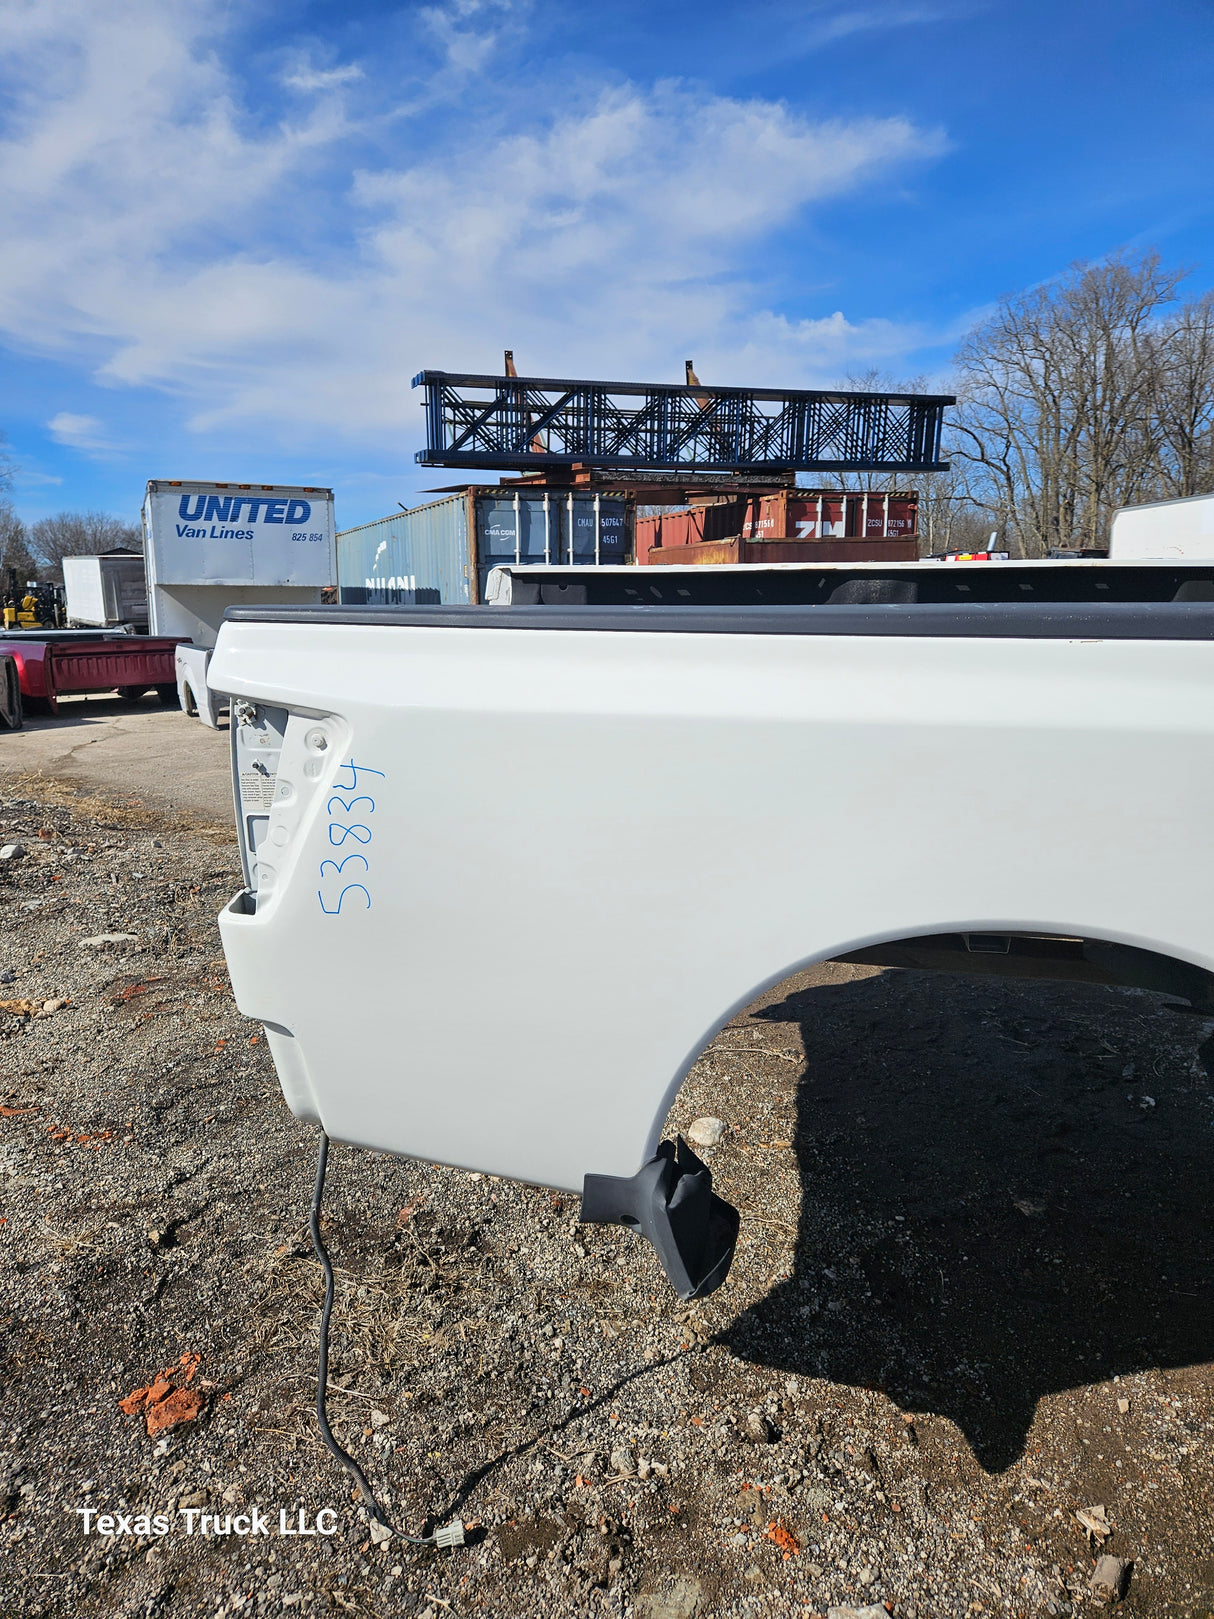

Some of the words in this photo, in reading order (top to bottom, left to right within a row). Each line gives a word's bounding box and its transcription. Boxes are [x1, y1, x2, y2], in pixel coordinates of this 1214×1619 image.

[178, 494, 311, 525] UNITED
[175, 524, 206, 538] Van
[209, 525, 254, 540] Lines
[291, 533, 307, 542] 825
[309, 533, 323, 542] 854
[602, 535, 618, 544] 45G1
[318, 758, 386, 915] 53834
